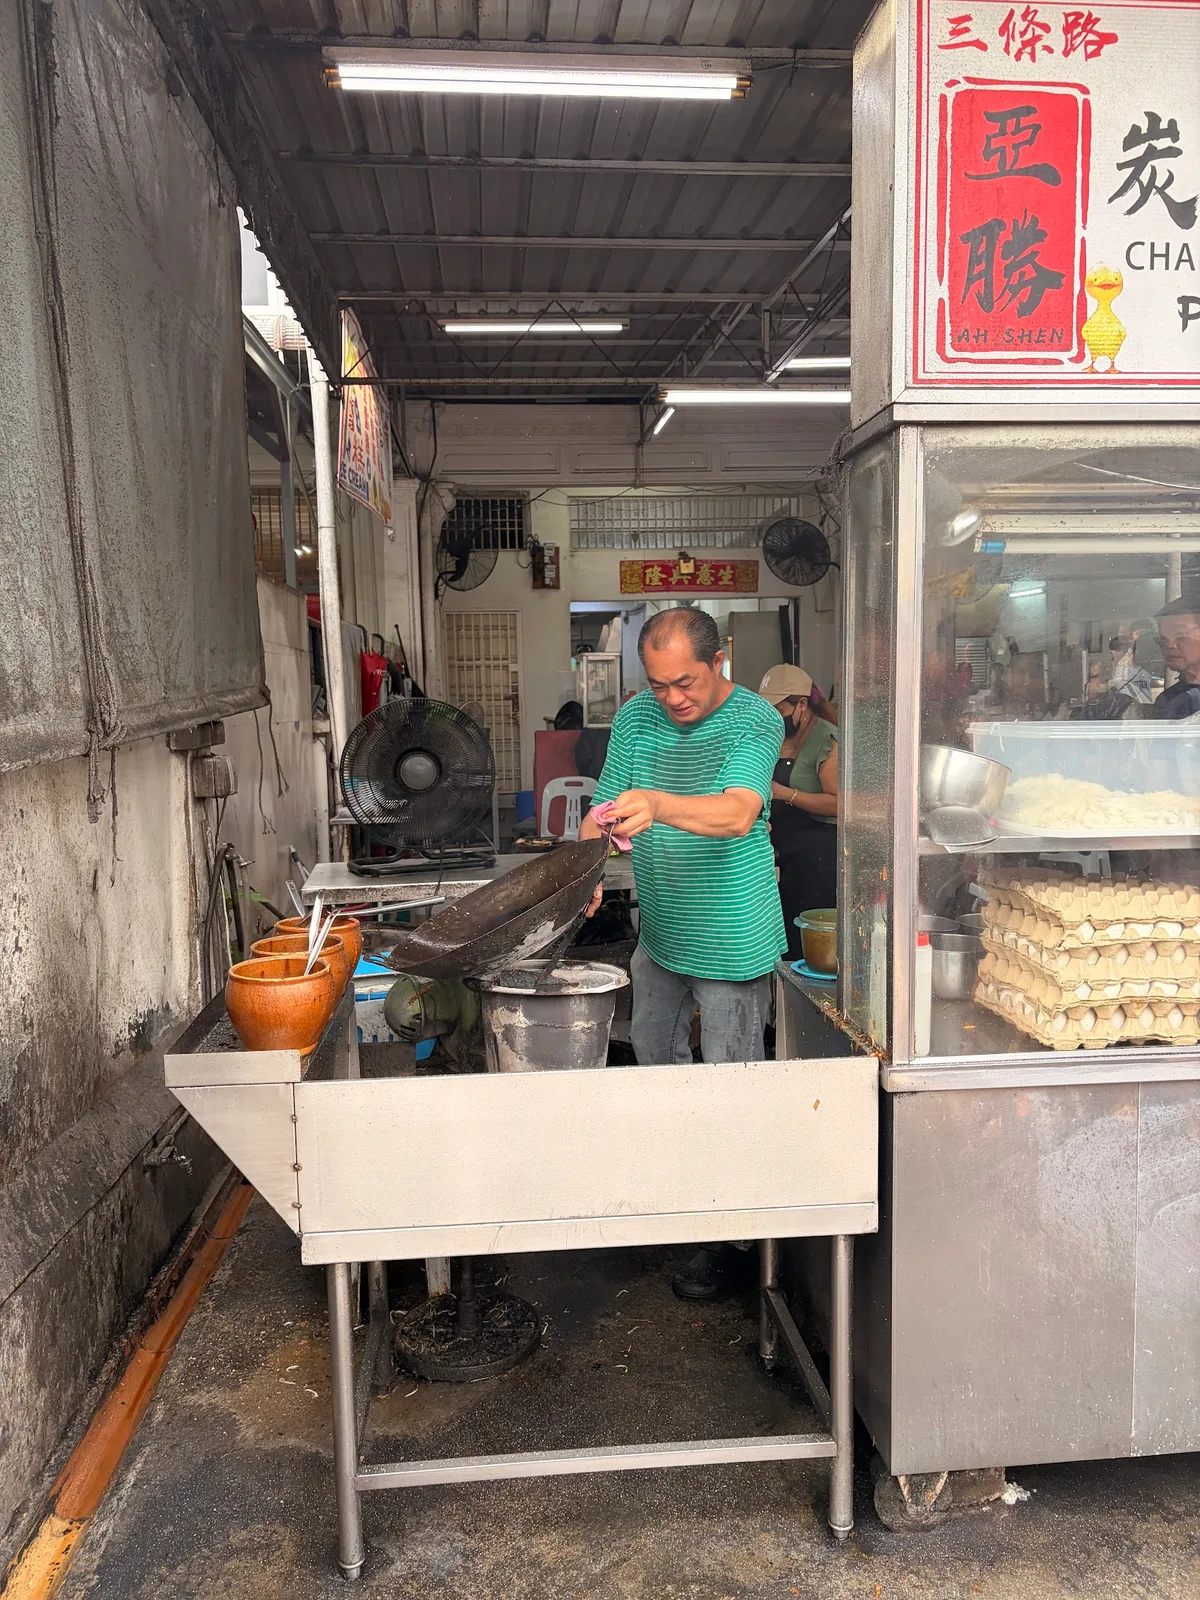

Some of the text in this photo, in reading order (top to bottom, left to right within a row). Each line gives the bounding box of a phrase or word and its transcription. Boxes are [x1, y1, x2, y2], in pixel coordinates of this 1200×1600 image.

[938, 5, 1119, 62] 三條路
[1107, 111, 1200, 230] 炭
[960, 105, 1067, 317] 亞勝
[1125, 240, 1196, 271] CHA
[957, 328, 1065, 343] AH SHEN
